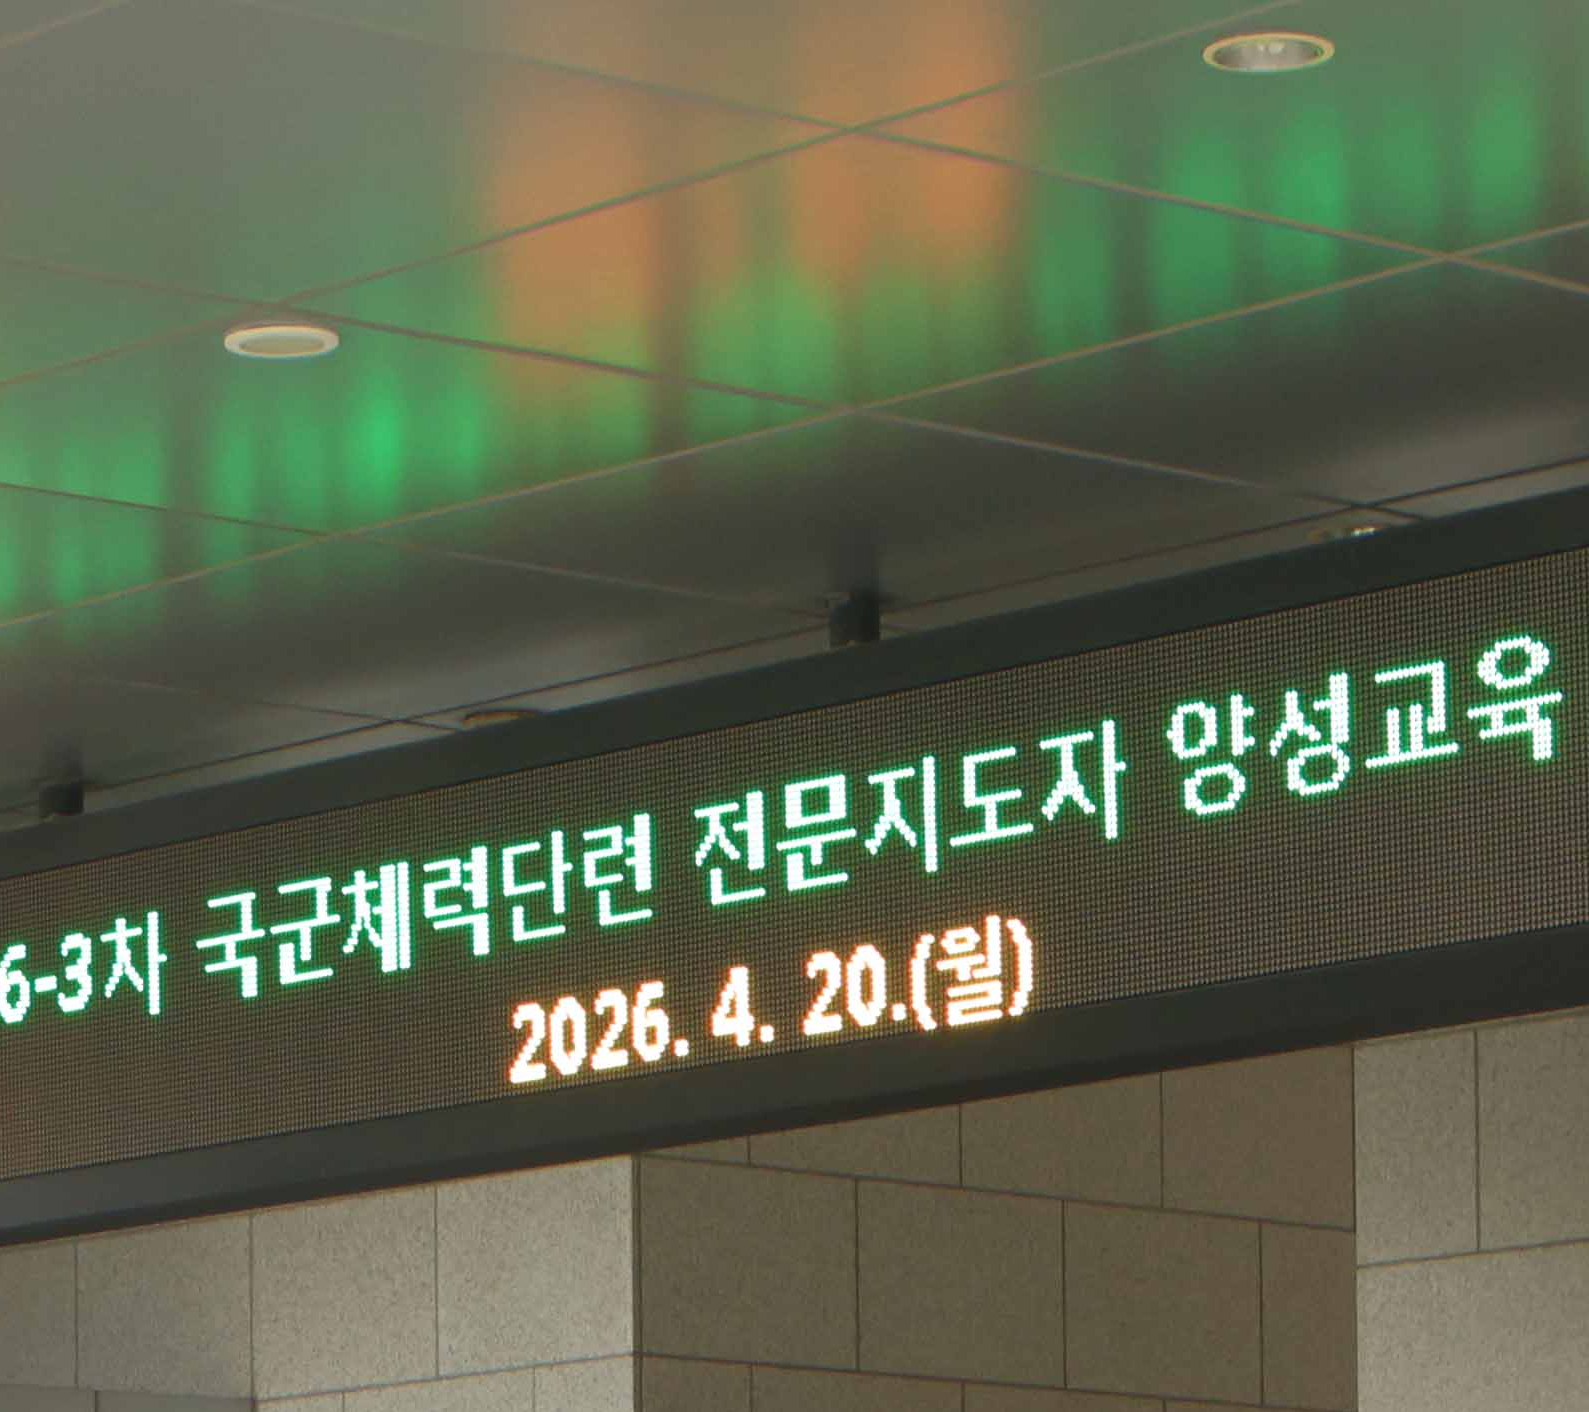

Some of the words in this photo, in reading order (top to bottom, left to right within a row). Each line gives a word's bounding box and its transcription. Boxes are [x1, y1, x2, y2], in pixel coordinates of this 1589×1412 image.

[196, 813, 652, 997] 국군체력단련
[694, 720, 1126, 905] 전문지도자
[1167, 635, 1562, 816] 양성교육
[509, 981, 689, 1083] 2026.
[710, 965, 774, 1046] 4.
[802, 915, 1033, 1036] 20.(월)
